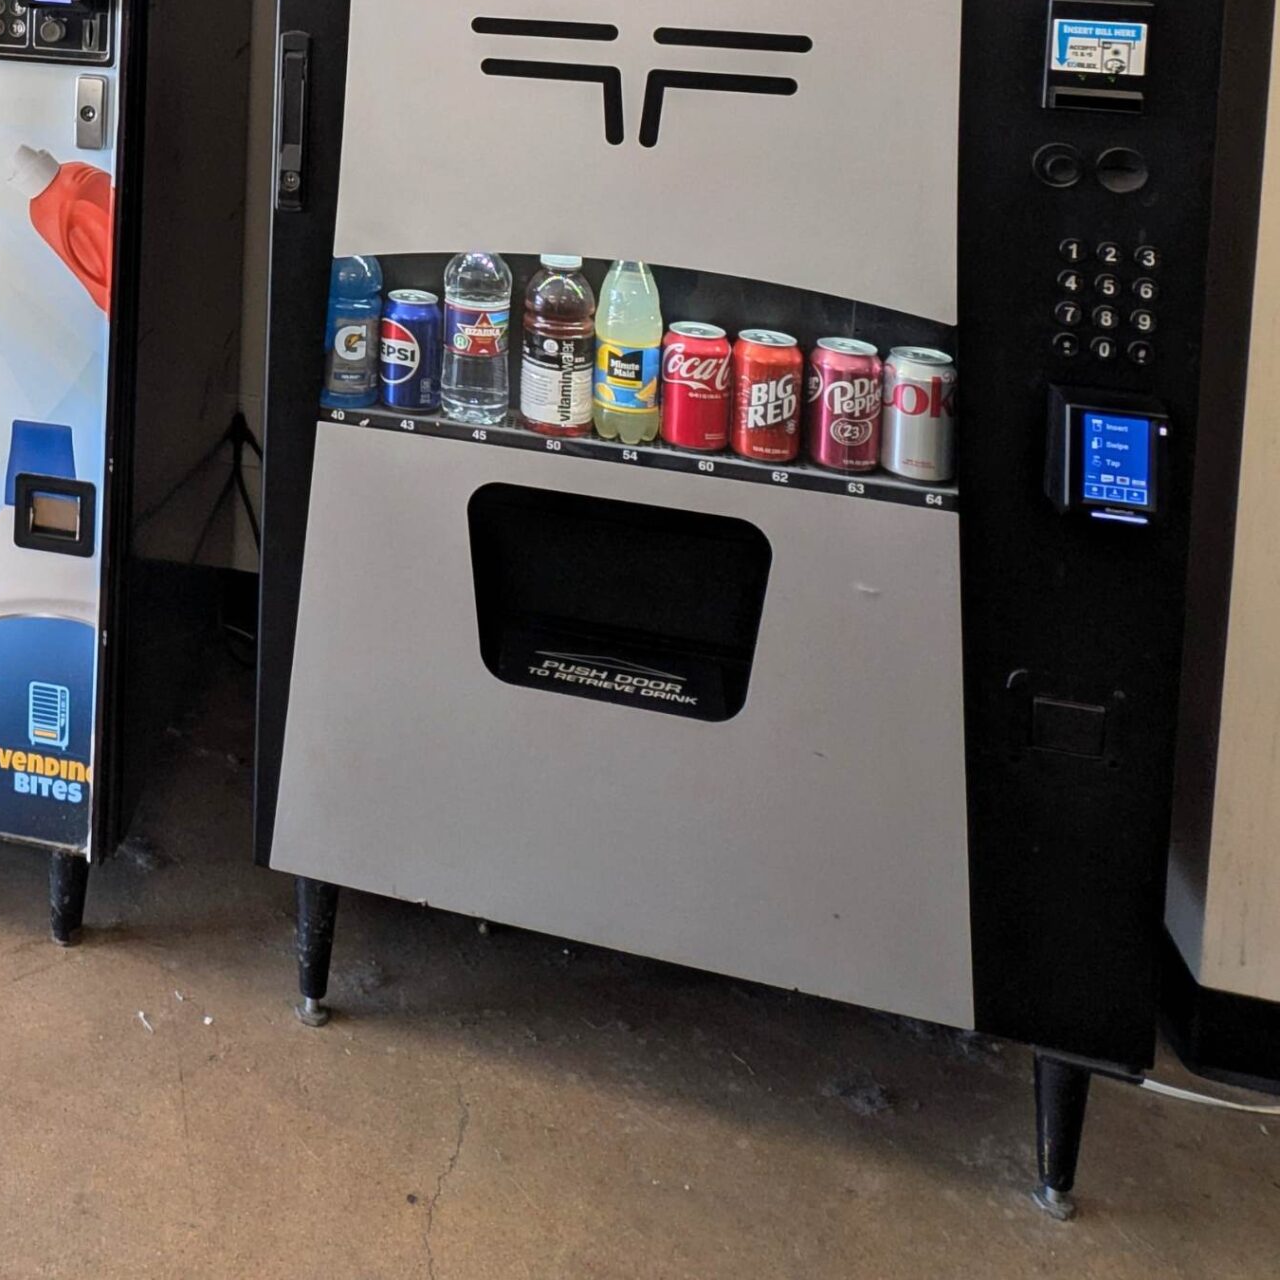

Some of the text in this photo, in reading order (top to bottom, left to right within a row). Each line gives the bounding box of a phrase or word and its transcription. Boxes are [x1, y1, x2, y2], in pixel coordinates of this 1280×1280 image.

[1064, 25, 1136, 37] INSERT BILL HERE
[381, 342, 415, 362] EPSI
[610, 359, 640, 371] Minute
[613, 368, 635, 379] Maid
[557, 340, 574, 422] vitaminwater
[751, 374, 793, 406] BIG
[854, 378, 878, 398] Dr
[331, 410, 345, 420] 40
[748, 395, 797, 428] RED
[400, 420, 414, 430] 43
[1106, 423, 1129, 434] Insert
[472, 430, 486, 440] 45
[844, 425, 860, 438] 23
[546, 440, 561, 450] 50
[1105, 441, 1129, 452] Swipe
[622, 450, 638, 461] 54
[698, 461, 714, 471] 60
[1105, 458, 1121, 468] Tap
[772, 471, 788, 483] 62
[848, 483, 864, 494] 63
[925, 494, 942, 506] 64
[542, 660, 682, 694] PUSH DOOR
[528, 666, 698, 706] TO RETRIEVE DRINK
